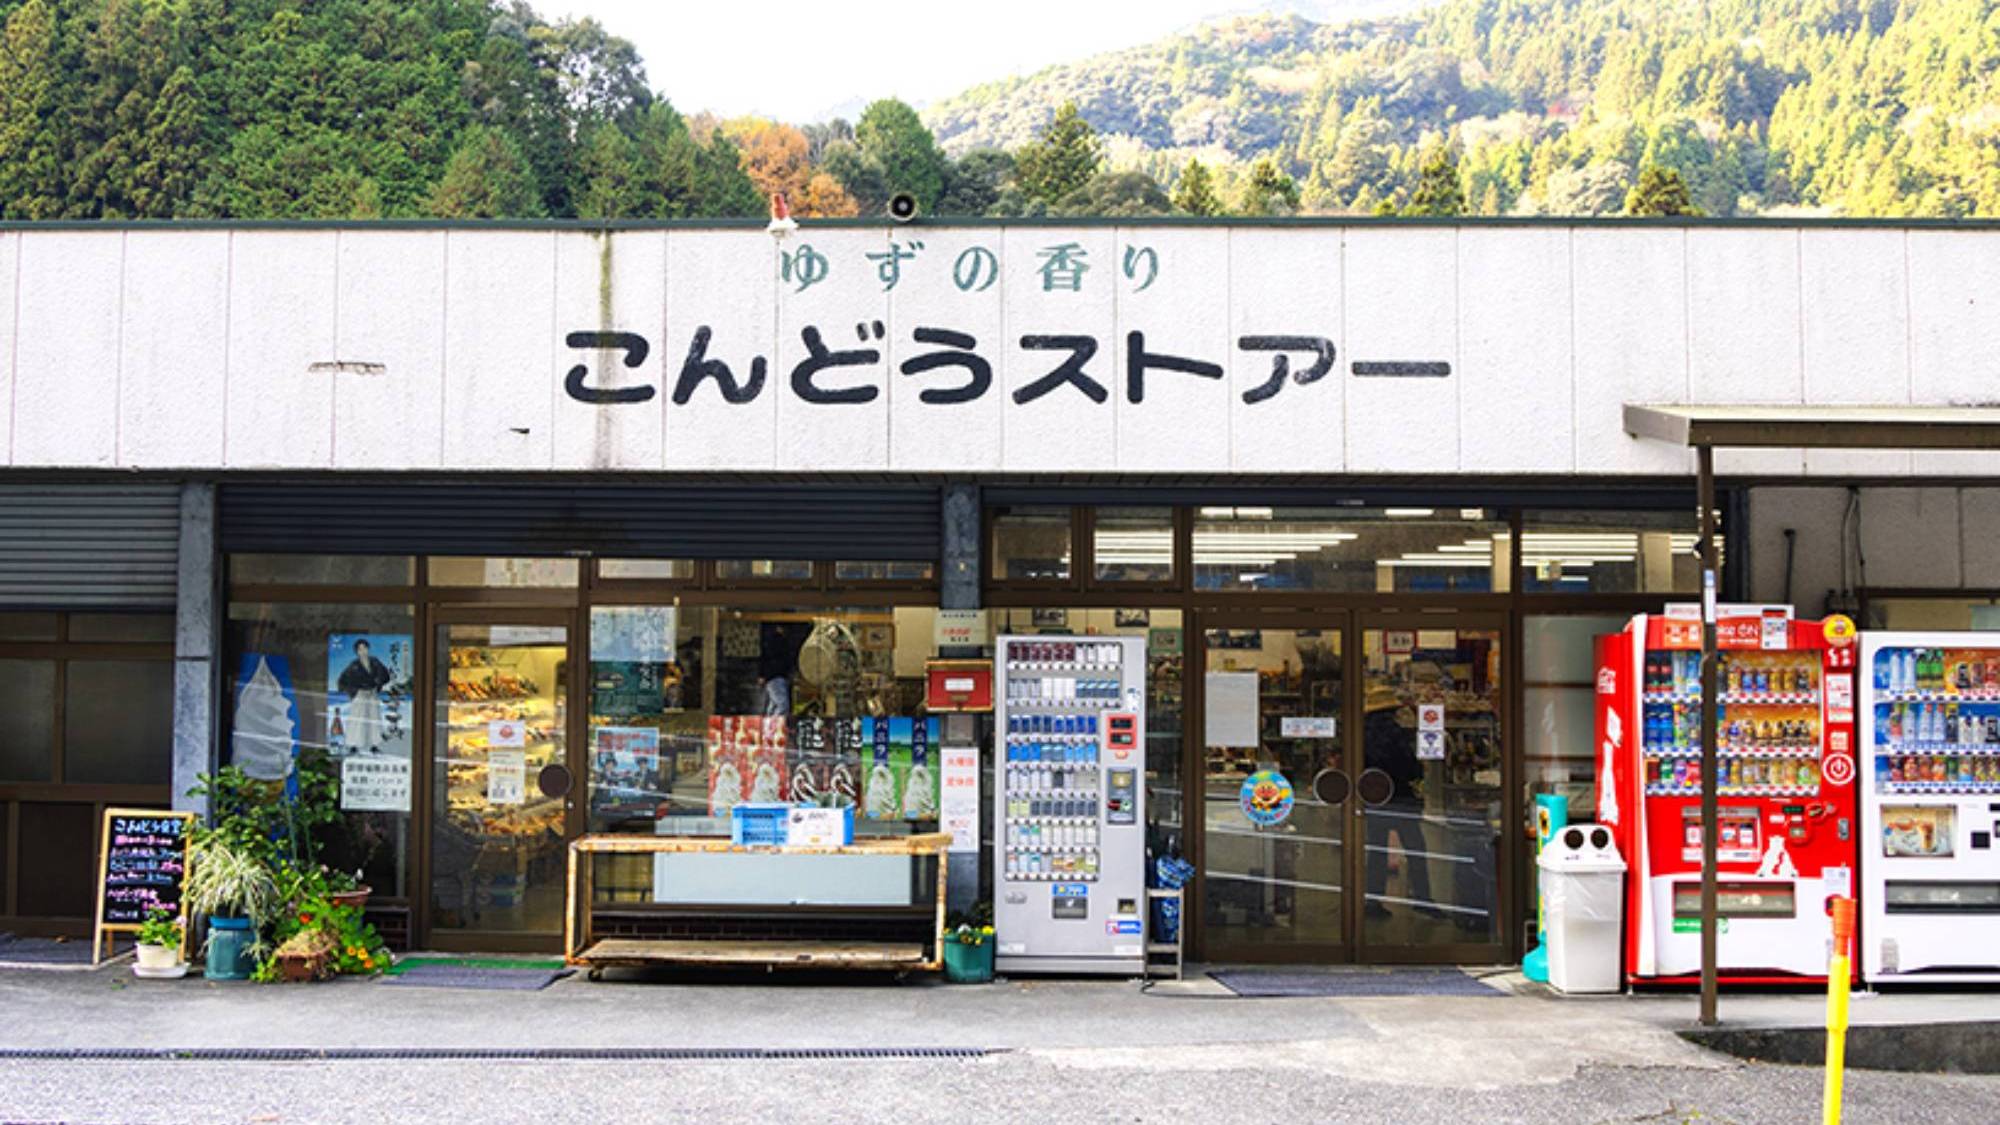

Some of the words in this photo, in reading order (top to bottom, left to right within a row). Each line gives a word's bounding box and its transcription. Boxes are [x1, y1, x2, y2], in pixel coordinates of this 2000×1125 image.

[781, 241, 1160, 292] ゆずの香り
[564, 319, 1452, 405] こんどうストアー
